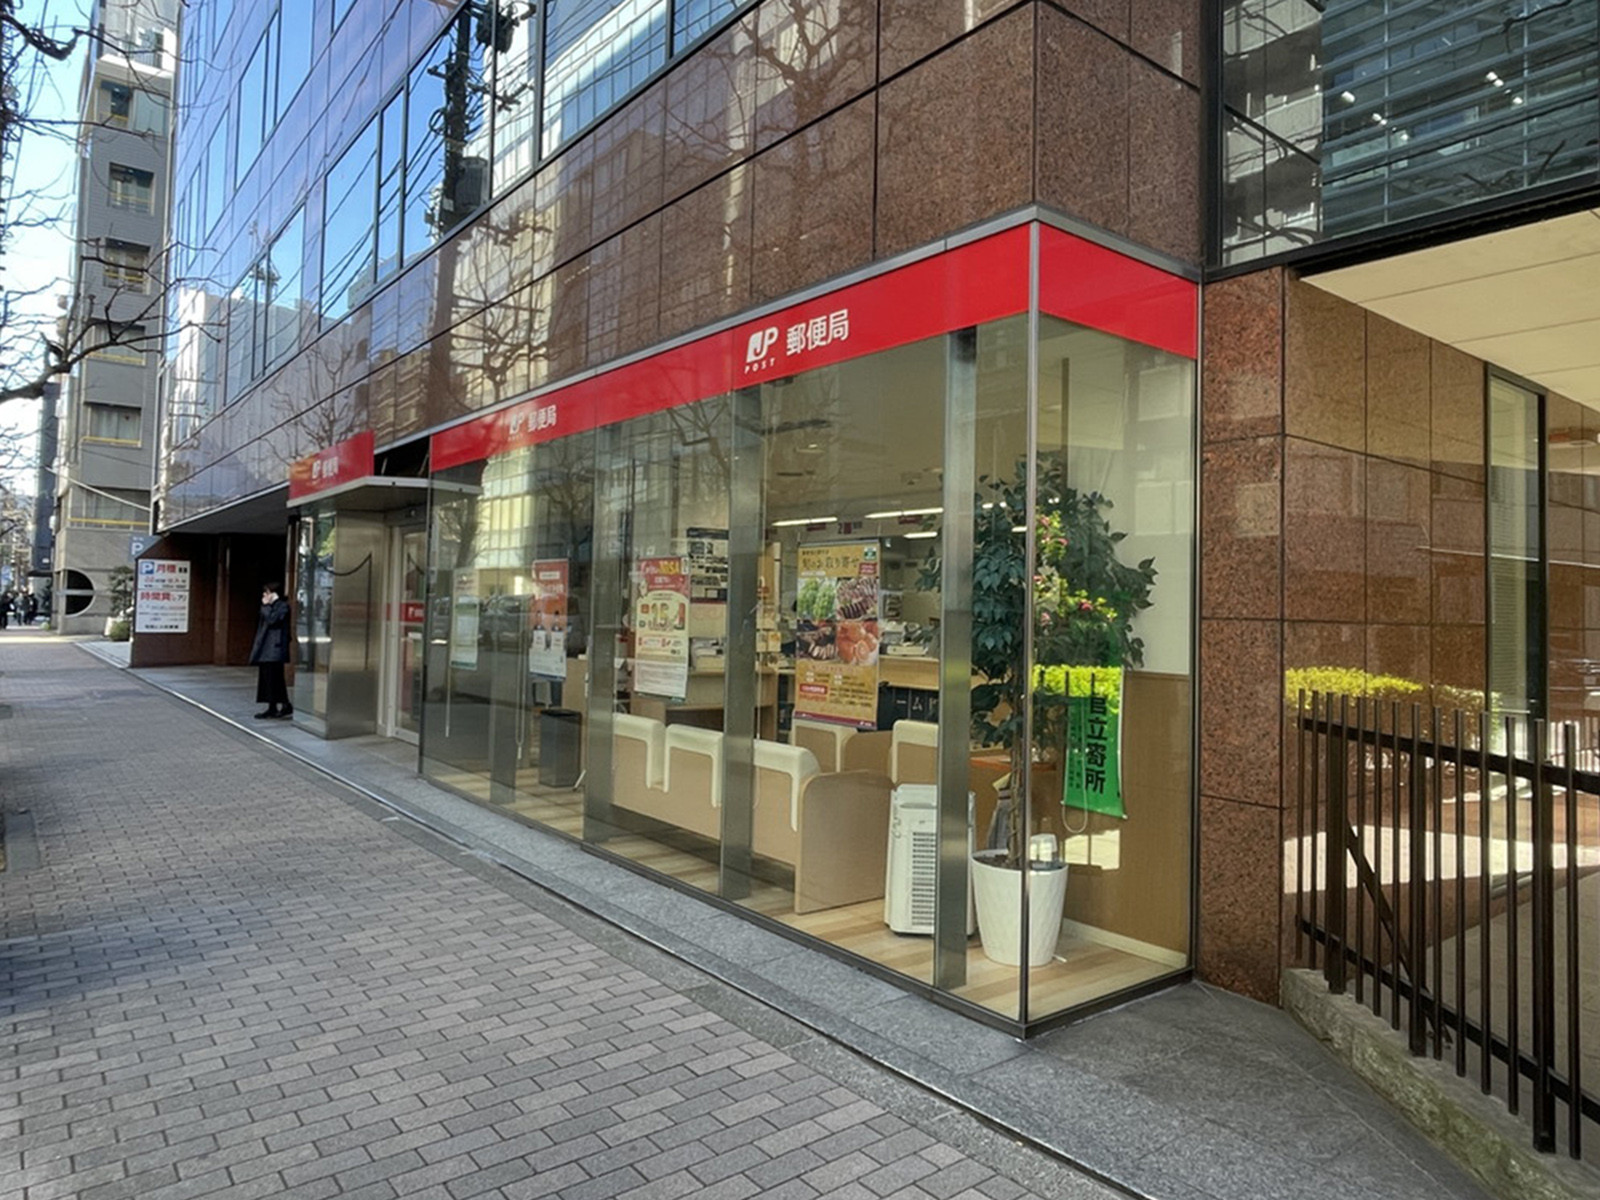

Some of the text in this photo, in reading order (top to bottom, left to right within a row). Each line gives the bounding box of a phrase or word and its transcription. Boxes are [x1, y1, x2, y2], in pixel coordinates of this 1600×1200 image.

[786, 309, 849, 356] 郵便局
[744, 357, 776, 375] POST
[527, 404, 557, 432] 郵便局
[131, 542, 144, 556] P
[142, 562, 154, 574] P
